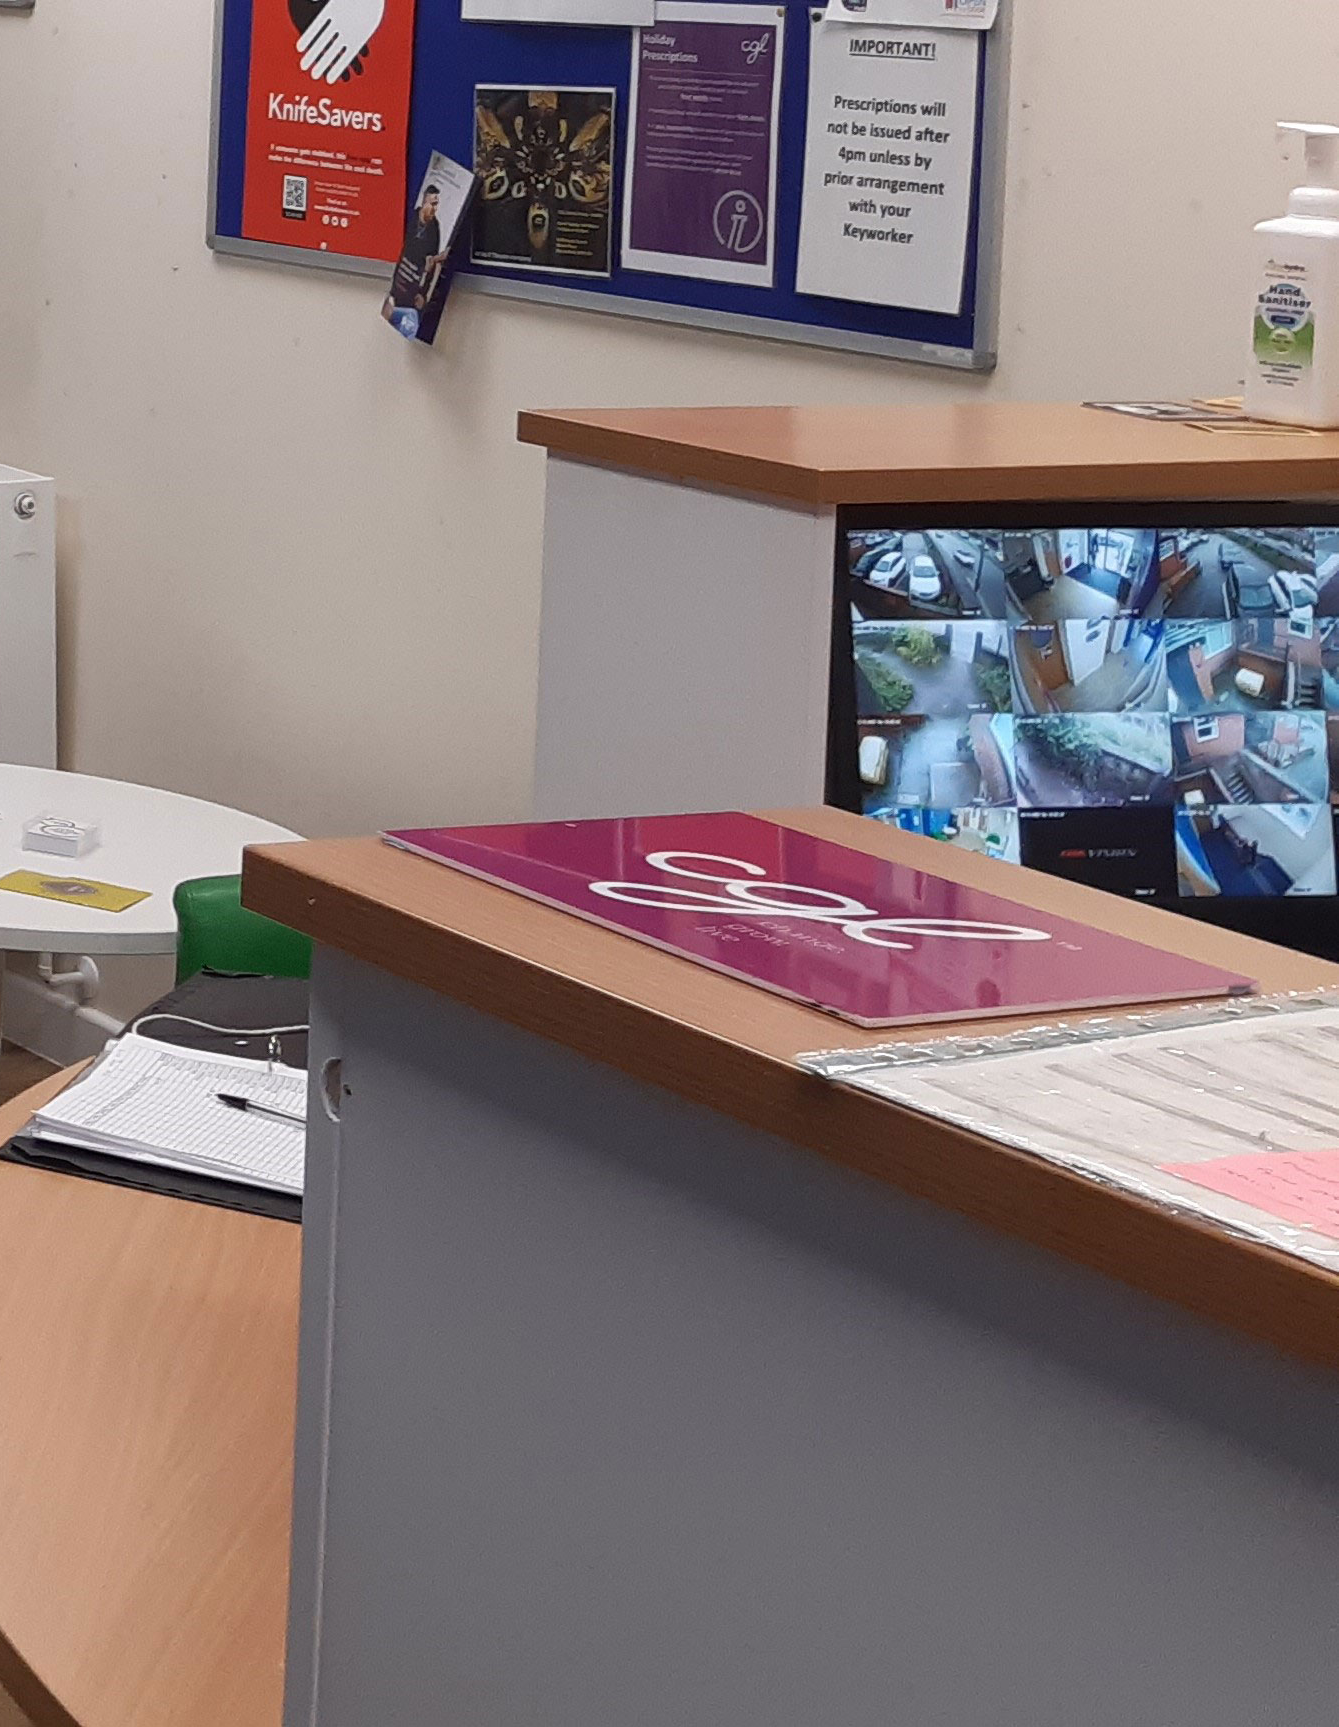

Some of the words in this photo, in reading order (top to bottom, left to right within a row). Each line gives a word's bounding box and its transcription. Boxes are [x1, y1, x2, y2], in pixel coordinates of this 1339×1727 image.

[642, 34, 676, 47] Holiday
[741, 33, 770, 64] cgl
[849, 38, 936, 60] IMPORTANT!
[642, 50, 698, 64] Prescriptions
[833, 95, 917, 116] Prescriptions
[921, 102, 946, 117] will
[827, 121, 848, 135] not
[851, 123, 866, 137] be
[870, 124, 911, 141] issued
[915, 129, 950, 144] after
[838, 146, 866, 164] 4pm
[870, 152, 910, 167] unless
[914, 154, 932, 171] by
[823, 172, 854, 187] prior
[857, 177, 945, 196] arrangement
[848, 199, 876, 214] with
[880, 204, 912, 219] your
[843, 222, 913, 245] Keyworker
[1258, 293, 1312, 308] Sanitiser
[1269, 284, 1301, 297] Hand
[588, 850, 1053, 950] cgl
